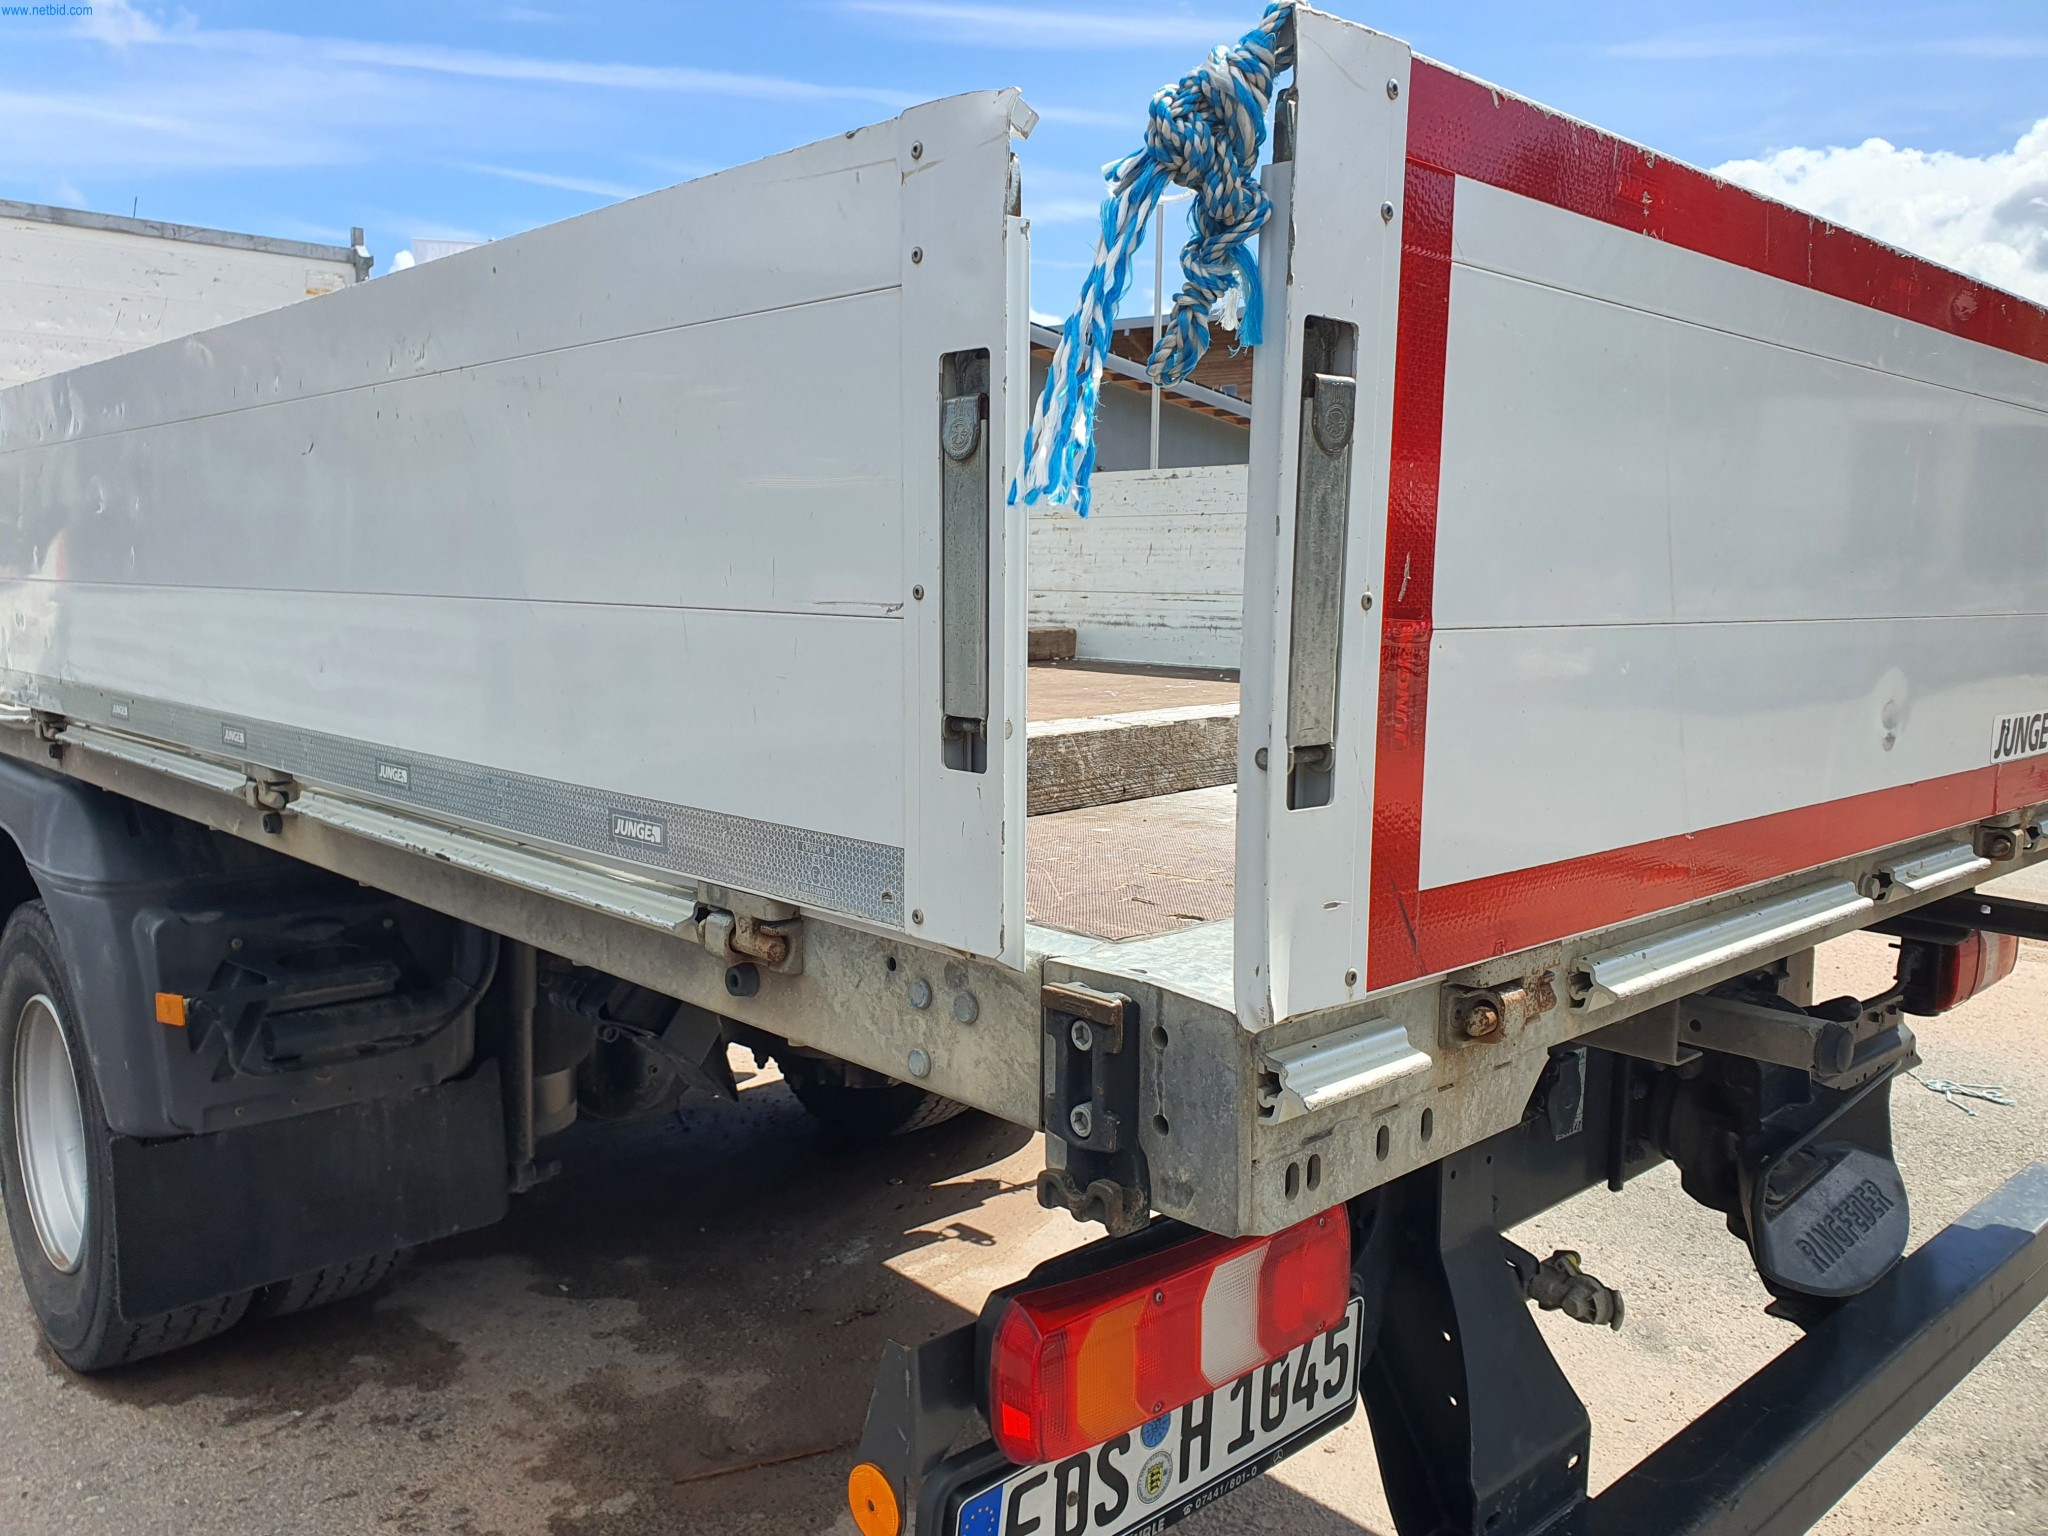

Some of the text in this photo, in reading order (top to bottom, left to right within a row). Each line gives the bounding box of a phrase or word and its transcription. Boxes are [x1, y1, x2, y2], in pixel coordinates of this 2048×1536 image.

[1795, 1179, 1895, 1274] RINGFEDER
[1179, 1391, 1214, 1484] H
[1227, 1316, 1350, 1455] 1045
[1195, 1466, 1257, 1509] 07441/801-0
